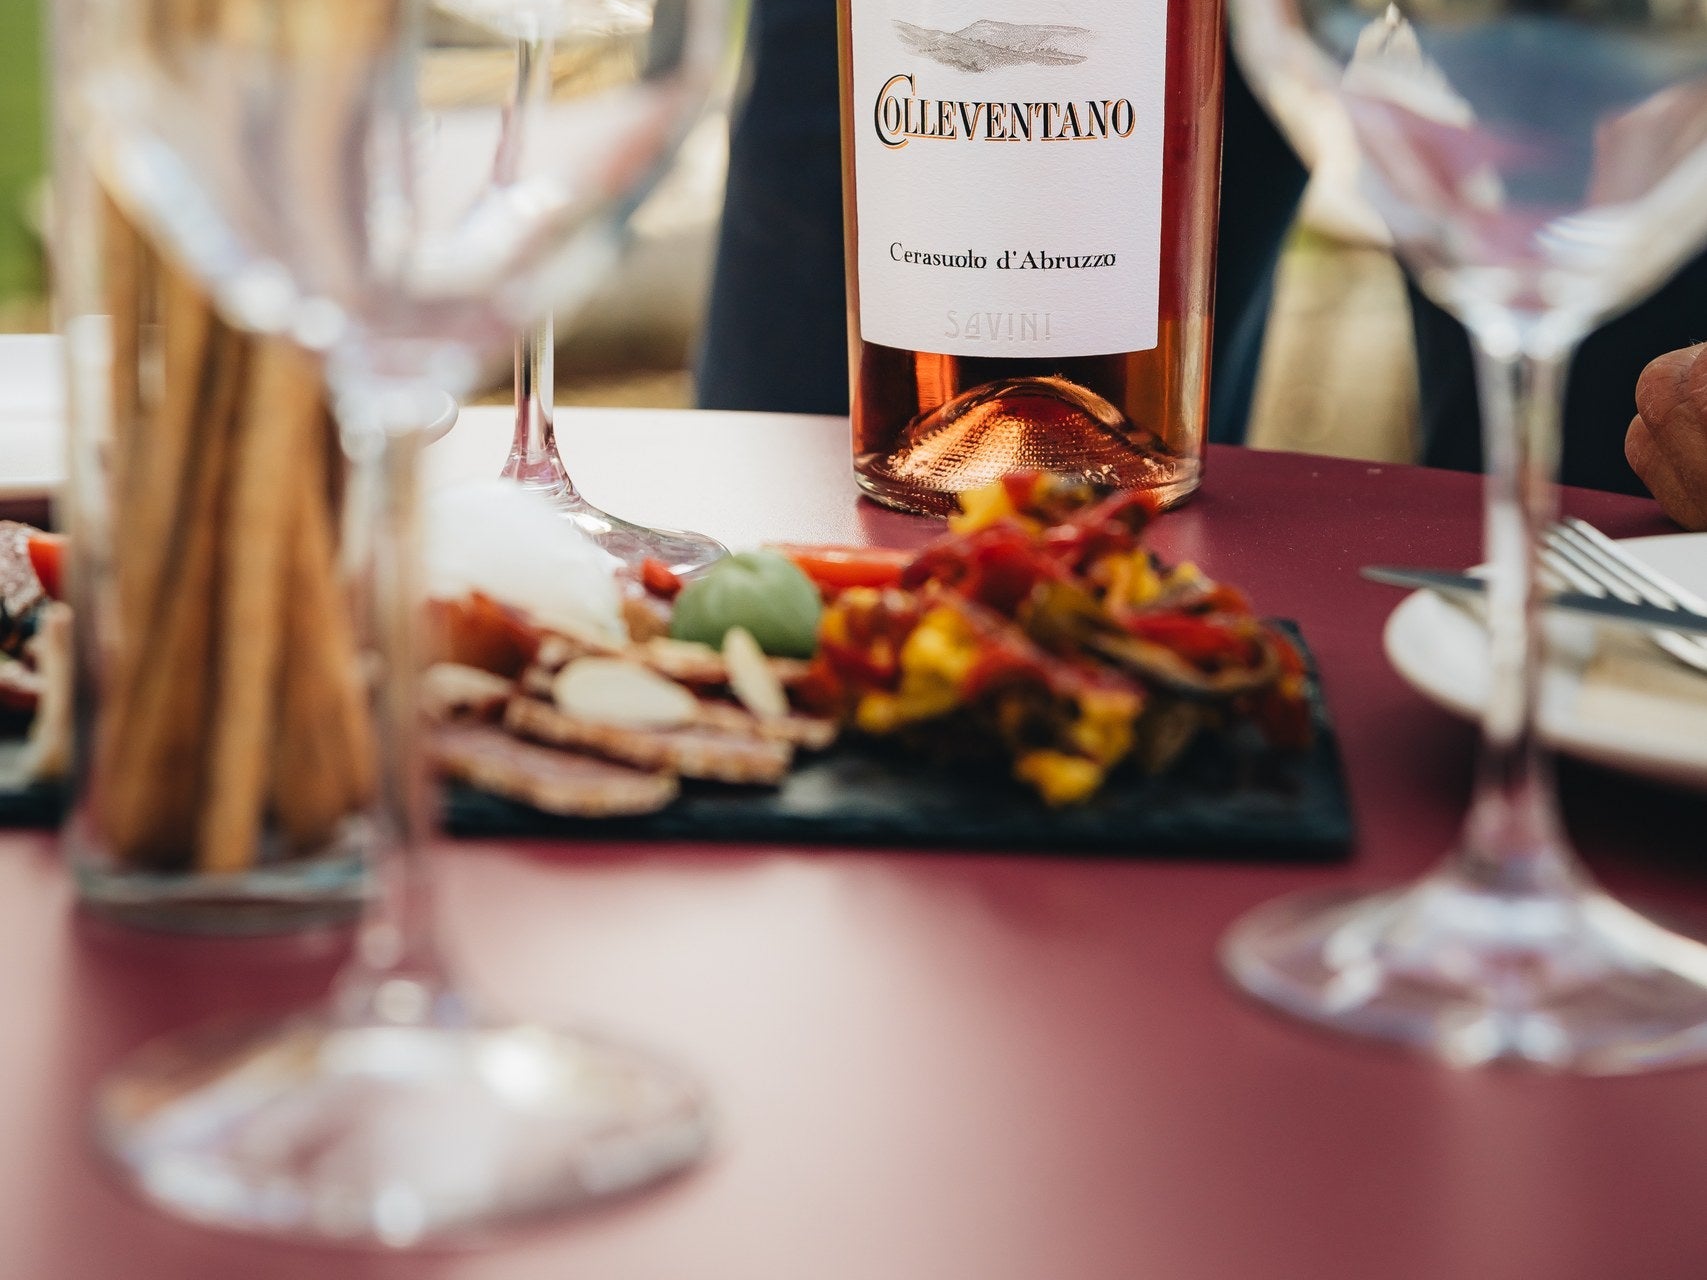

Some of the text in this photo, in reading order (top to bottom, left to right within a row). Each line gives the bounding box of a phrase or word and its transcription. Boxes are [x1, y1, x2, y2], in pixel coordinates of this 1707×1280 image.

[874, 73, 1136, 150] COLLEVENTANO
[889, 242, 1117, 271] Cerasuolo d'Abruzzo
[944, 310, 1052, 342] SAVINI
